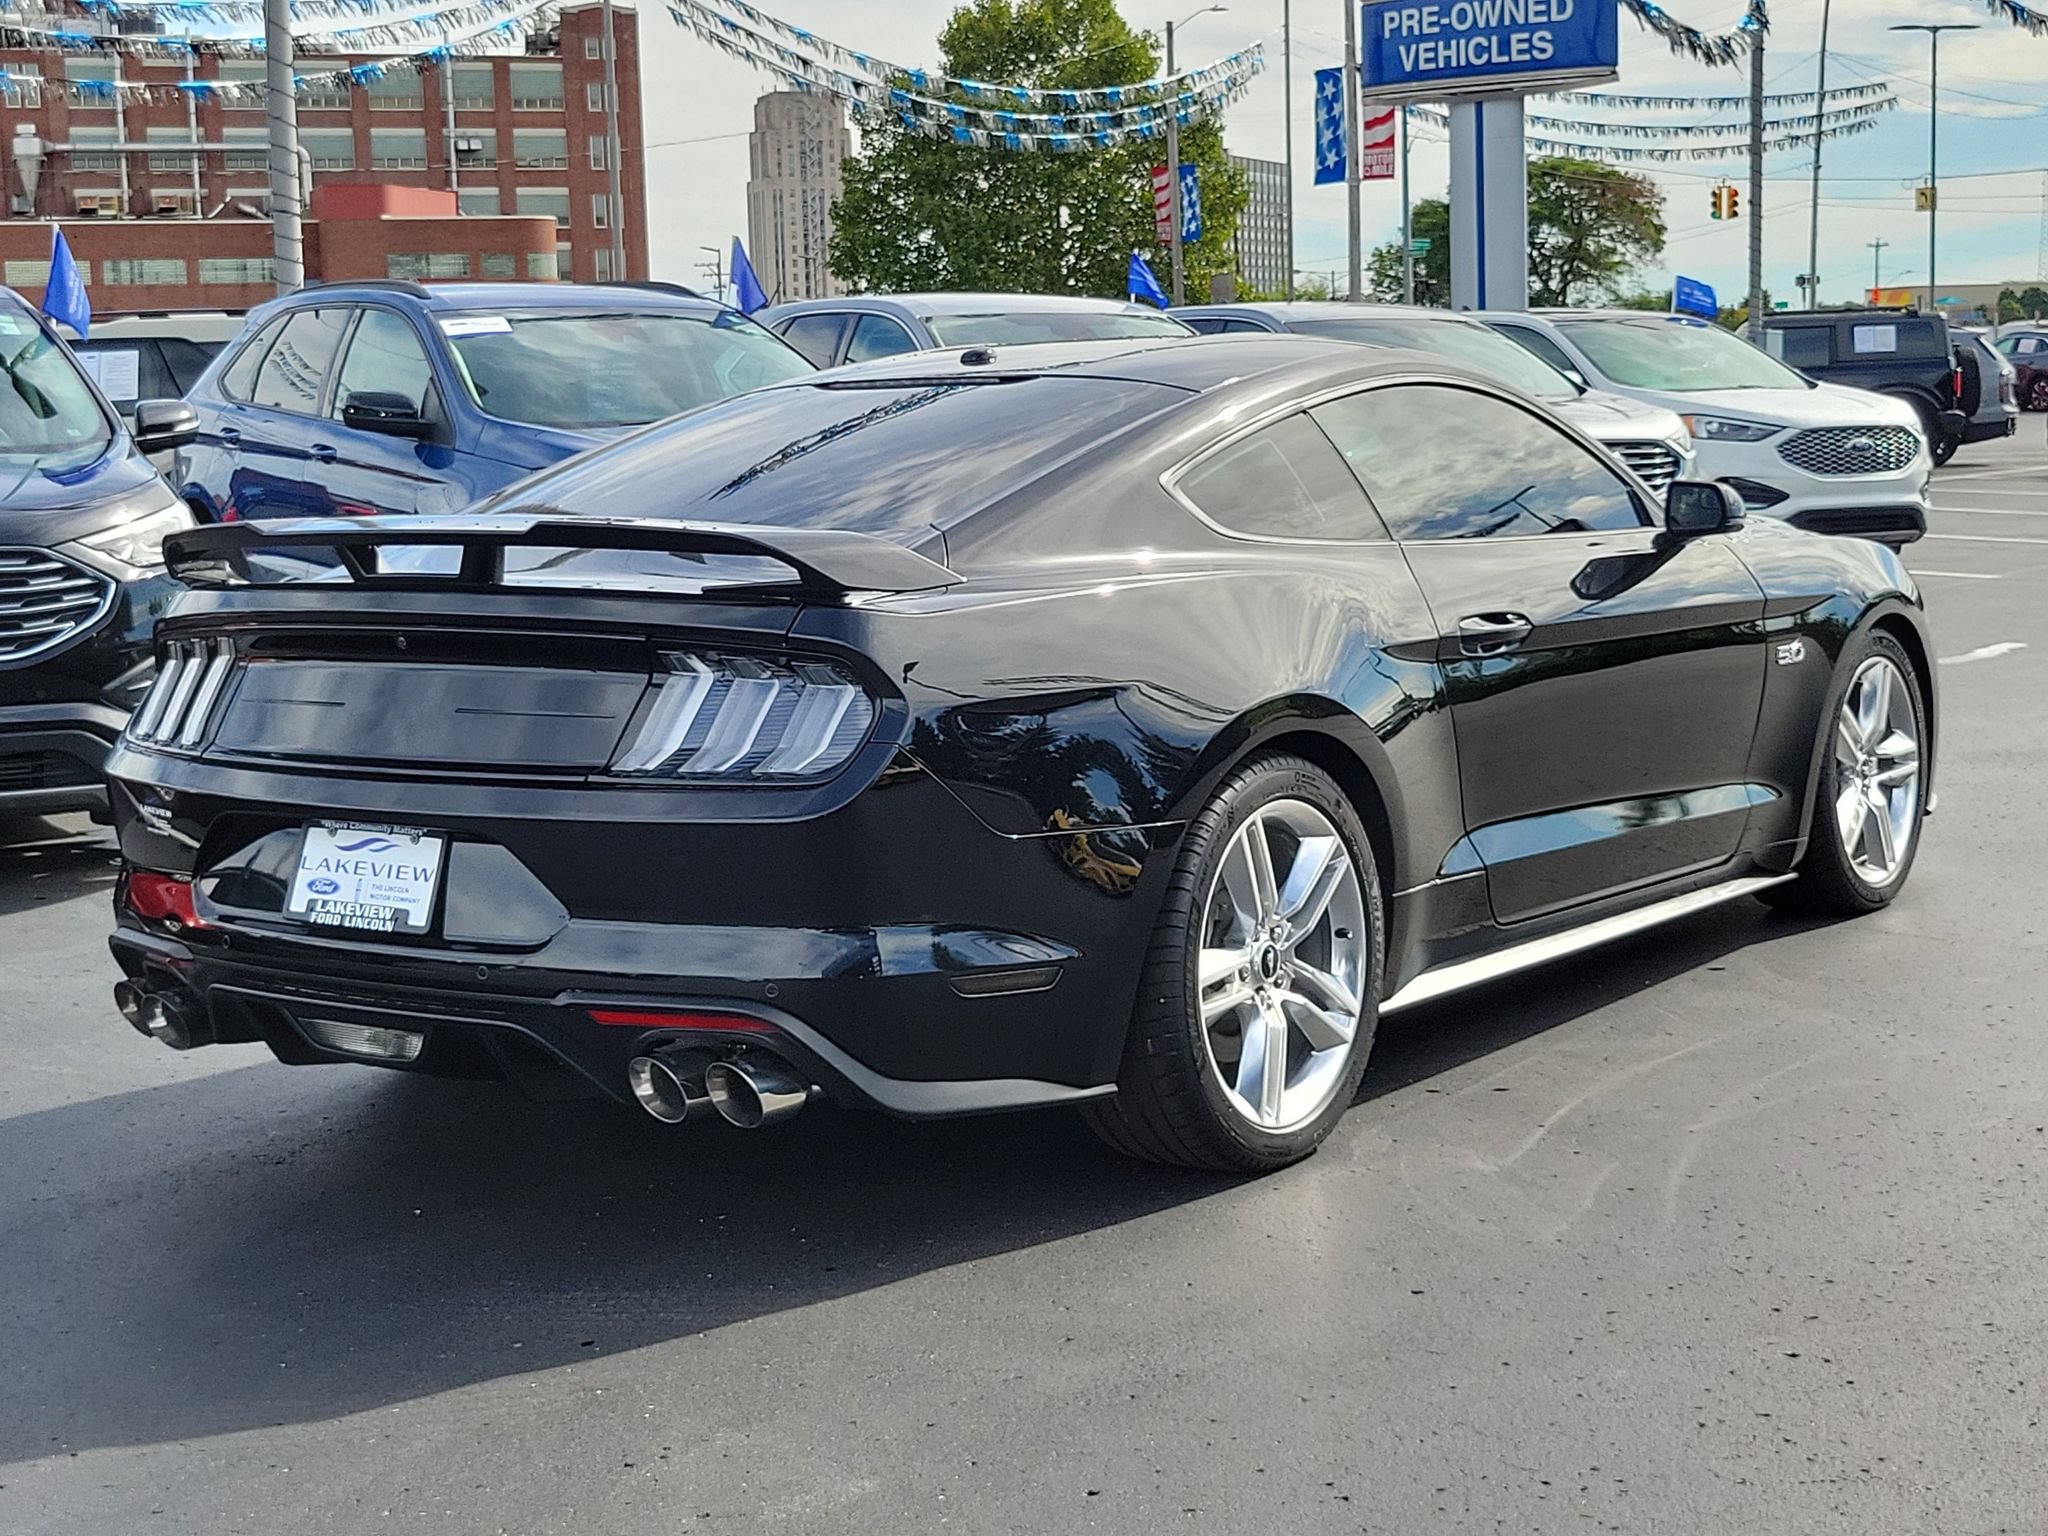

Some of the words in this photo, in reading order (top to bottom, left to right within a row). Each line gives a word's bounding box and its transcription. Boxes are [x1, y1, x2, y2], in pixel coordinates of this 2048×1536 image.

[1383, 0, 1575, 39] PRE-OWNED
[1399, 31, 1555, 72] VEHICLES
[301, 855, 435, 883] LAKEVIEW
[310, 911, 341, 926] FORD
[344, 915, 395, 932] LINCOLN
[315, 899, 395, 920] LAKEVIEW
